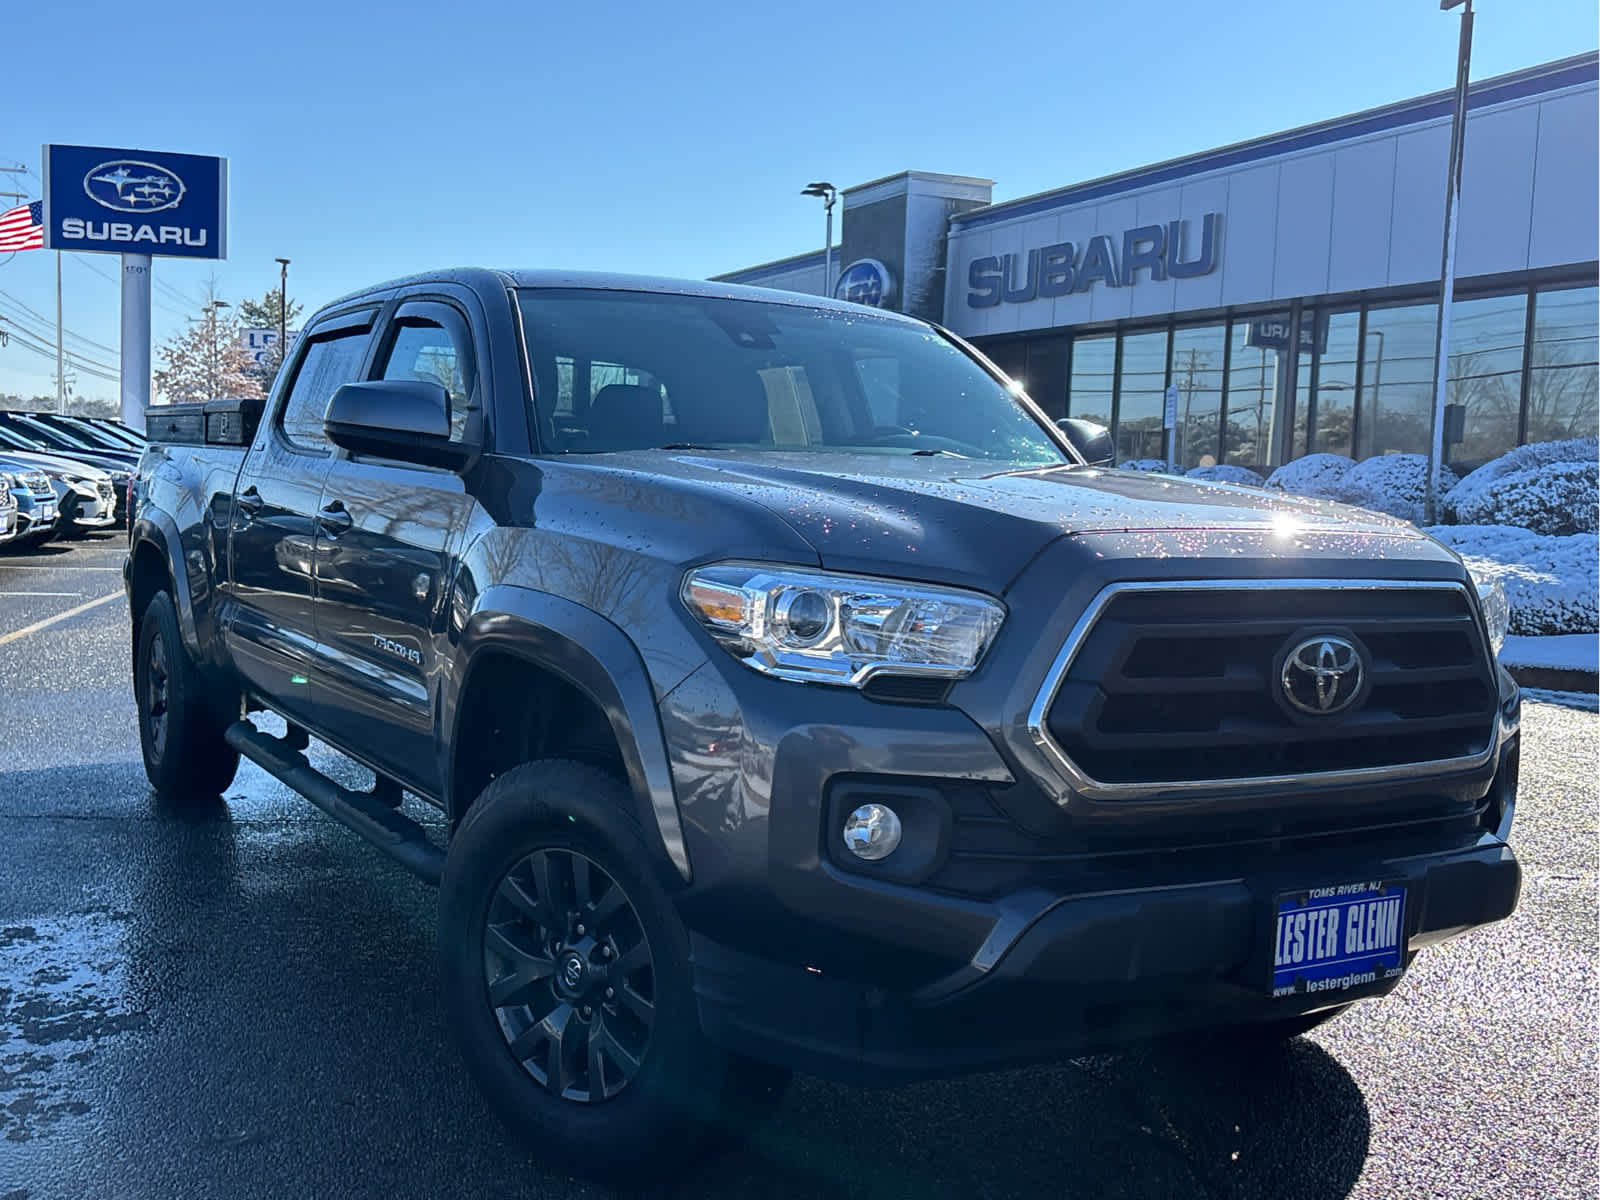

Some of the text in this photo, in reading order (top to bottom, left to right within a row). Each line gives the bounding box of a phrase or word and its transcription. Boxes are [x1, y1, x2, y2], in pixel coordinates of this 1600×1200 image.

[62, 217, 207, 247] SUBARU
[967, 212, 1217, 310] SUBARU
[1308, 887, 1335, 899] TOMS
[1368, 881, 1382, 891] NJ
[1274, 899, 1400, 966] LESTER GLENN
[1306, 971, 1376, 993] lesterglenn
